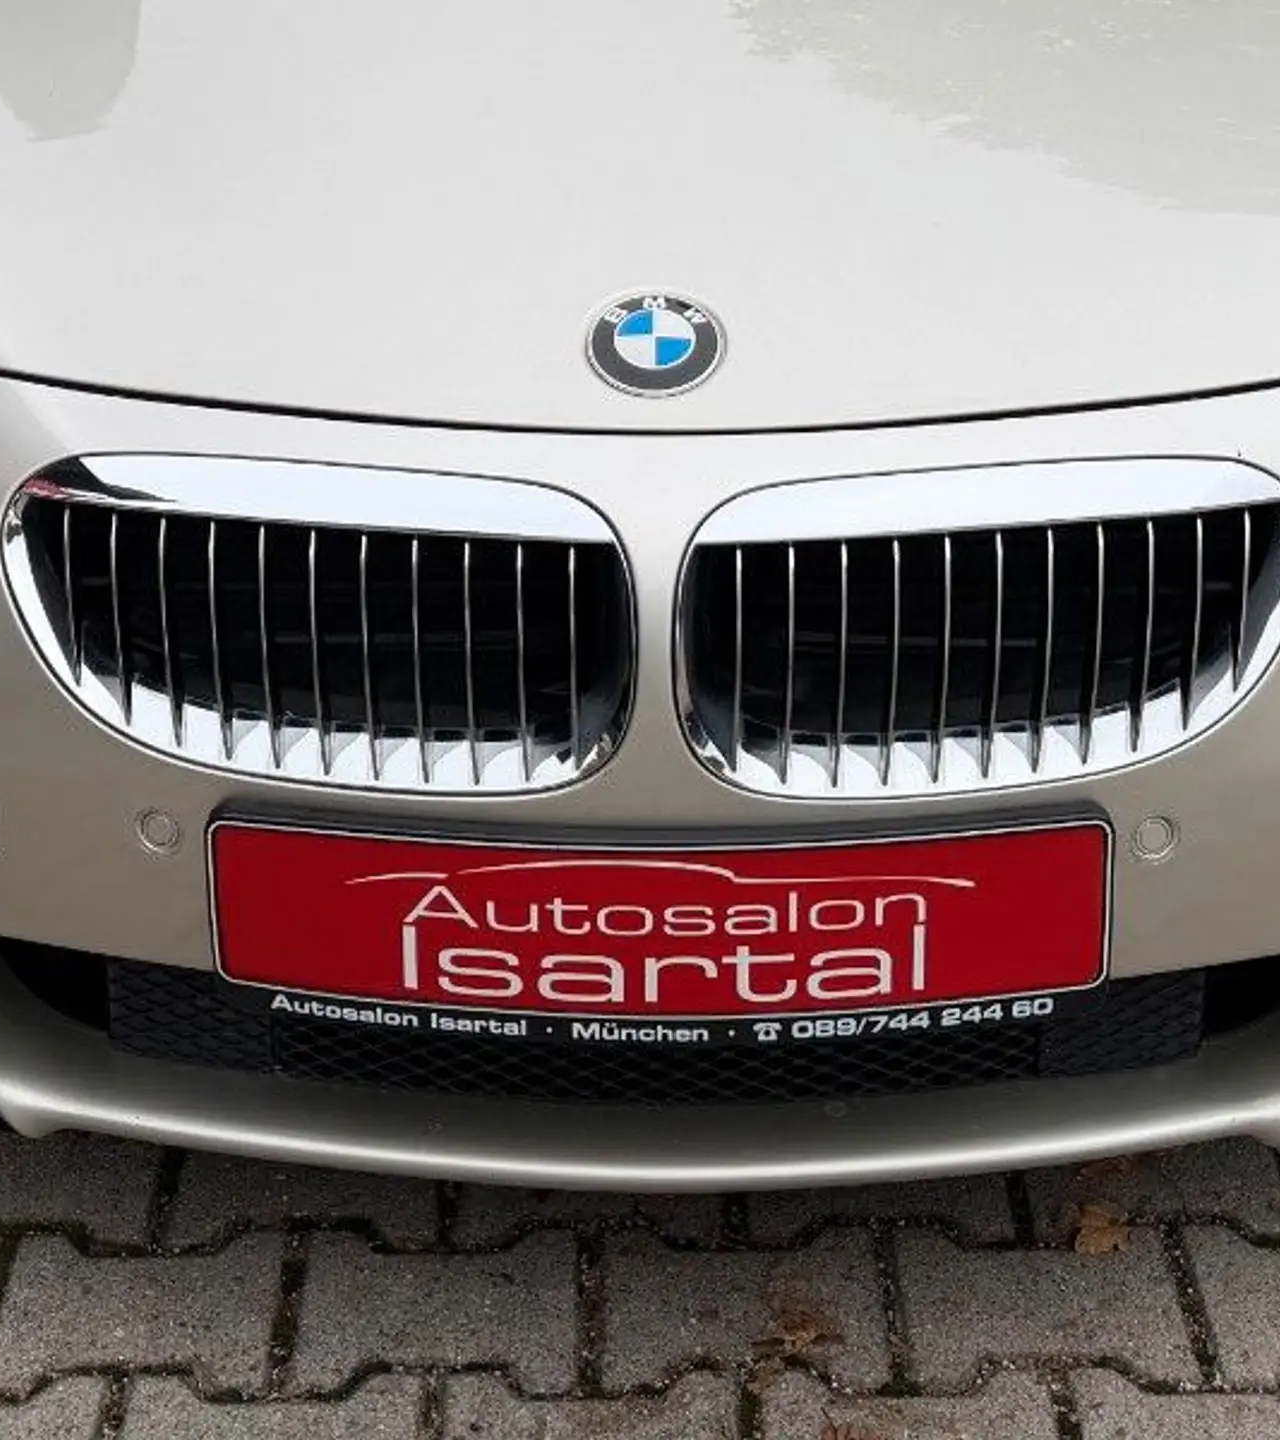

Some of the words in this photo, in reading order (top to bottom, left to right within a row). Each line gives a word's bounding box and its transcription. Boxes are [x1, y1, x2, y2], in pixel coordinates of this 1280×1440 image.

[604, 295, 707, 324] BMW
[402, 885, 927, 936] Autosalon
[402, 924, 926, 1003] Isartal
[271, 993, 418, 1027] Autosalon
[430, 1012, 527, 1036] Isartal
[572, 1022, 709, 1042] München
[791, 1011, 931, 1039] 089/744
[940, 1003, 1003, 1027] 244
[1011, 997, 1054, 1018] 60
